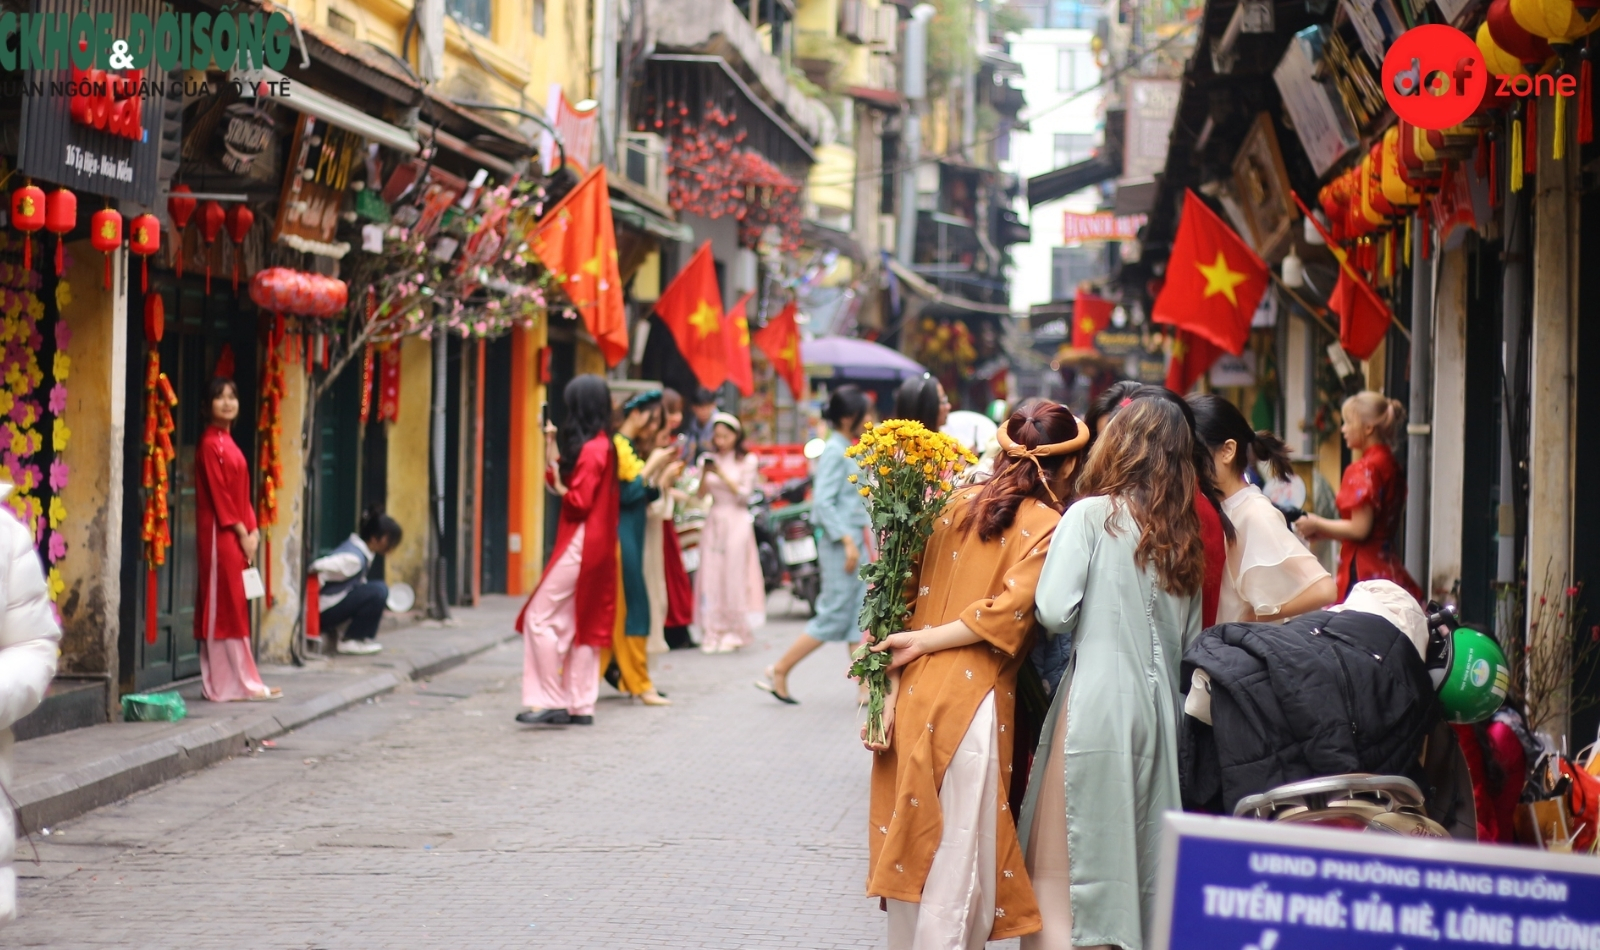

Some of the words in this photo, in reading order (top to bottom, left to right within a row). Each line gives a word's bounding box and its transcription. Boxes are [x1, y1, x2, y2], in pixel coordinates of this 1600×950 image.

[65, 144, 75, 167] 16
[1249, 852, 1318, 878] UBND
[1321, 859, 1421, 888] PHƯỜNG
[1425, 869, 1494, 895] HÀNG
[1497, 874, 1568, 902] BUỒM
[1203, 880, 1284, 922] TUYẾN
[1287, 889, 1347, 928] PHỐ:
[1352, 891, 1395, 933] VỈA
[1399, 901, 1440, 941] HÈ,
[1446, 905, 1514, 945] LÒNG
